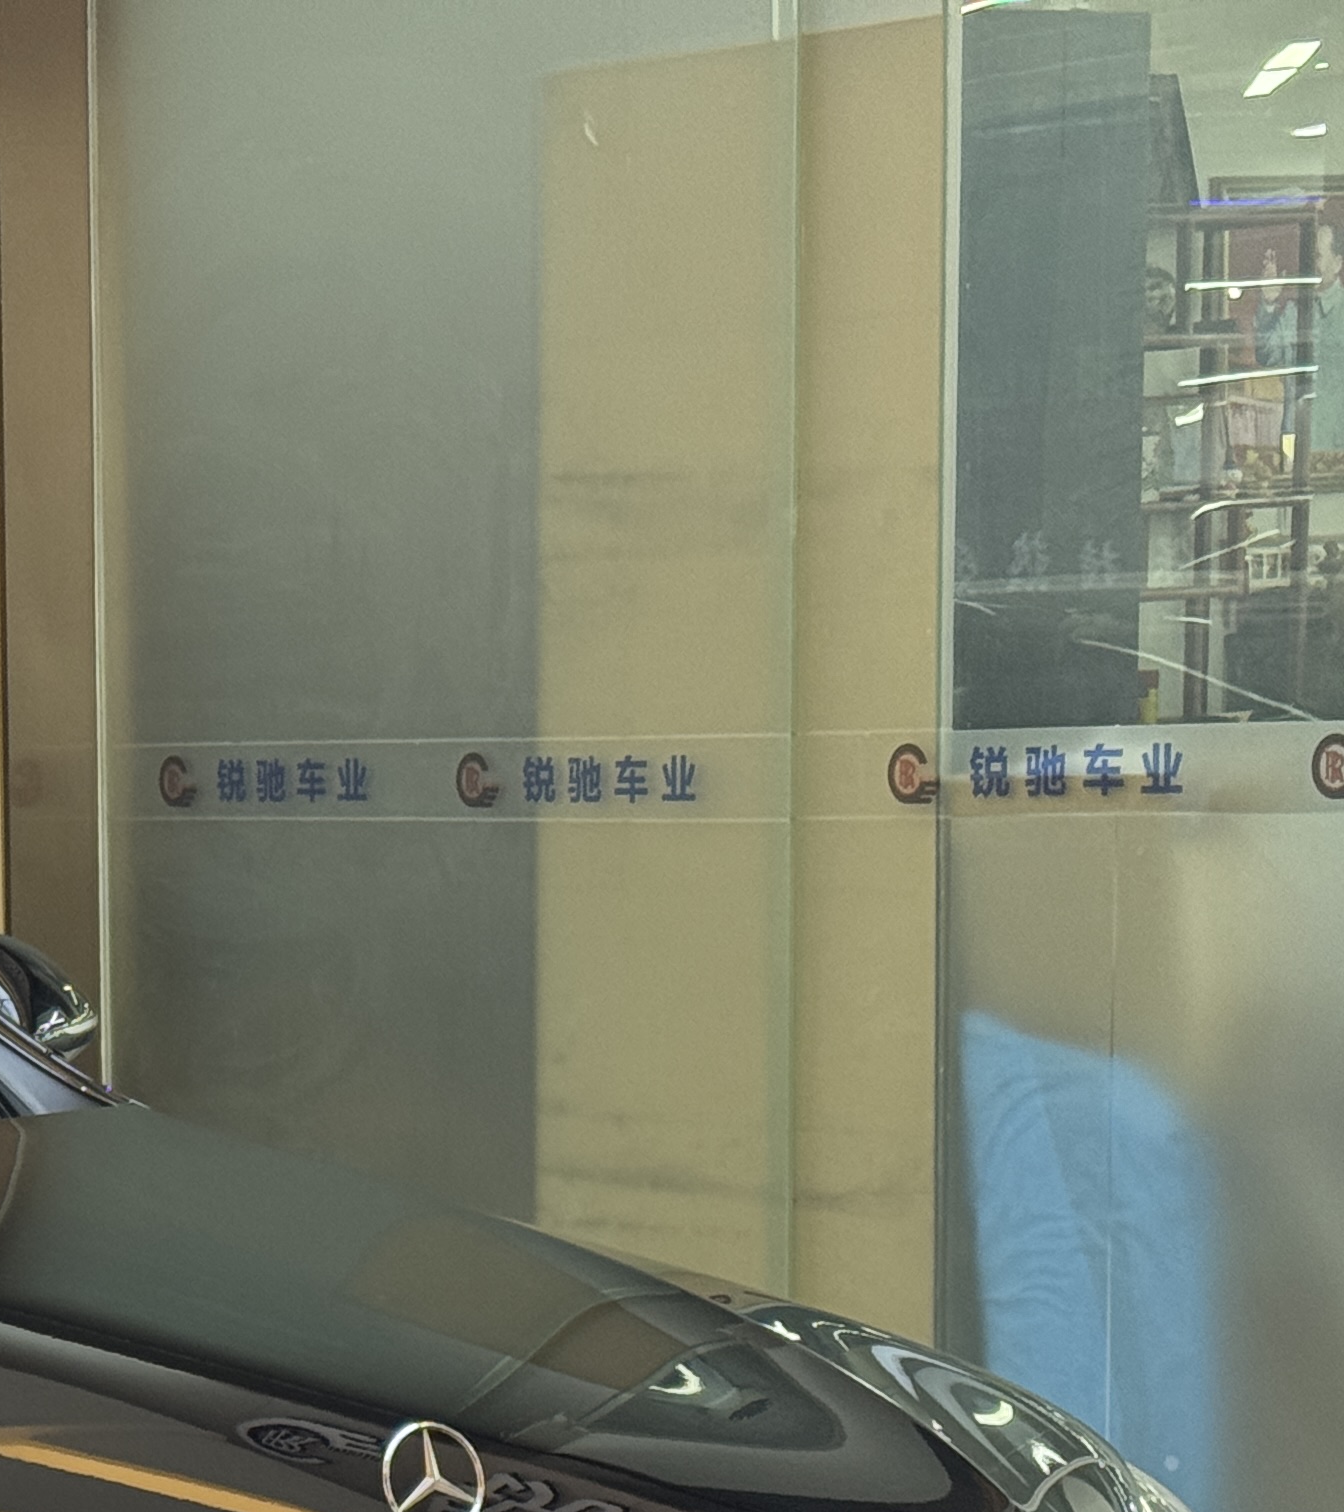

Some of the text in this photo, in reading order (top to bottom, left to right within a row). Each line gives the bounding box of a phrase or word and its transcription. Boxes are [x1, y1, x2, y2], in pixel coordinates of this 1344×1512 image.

[217, 757, 368, 804] 锐驰车业
[522, 754, 696, 804] 锐驰车业
[970, 742, 1184, 799] 锐驰车业
